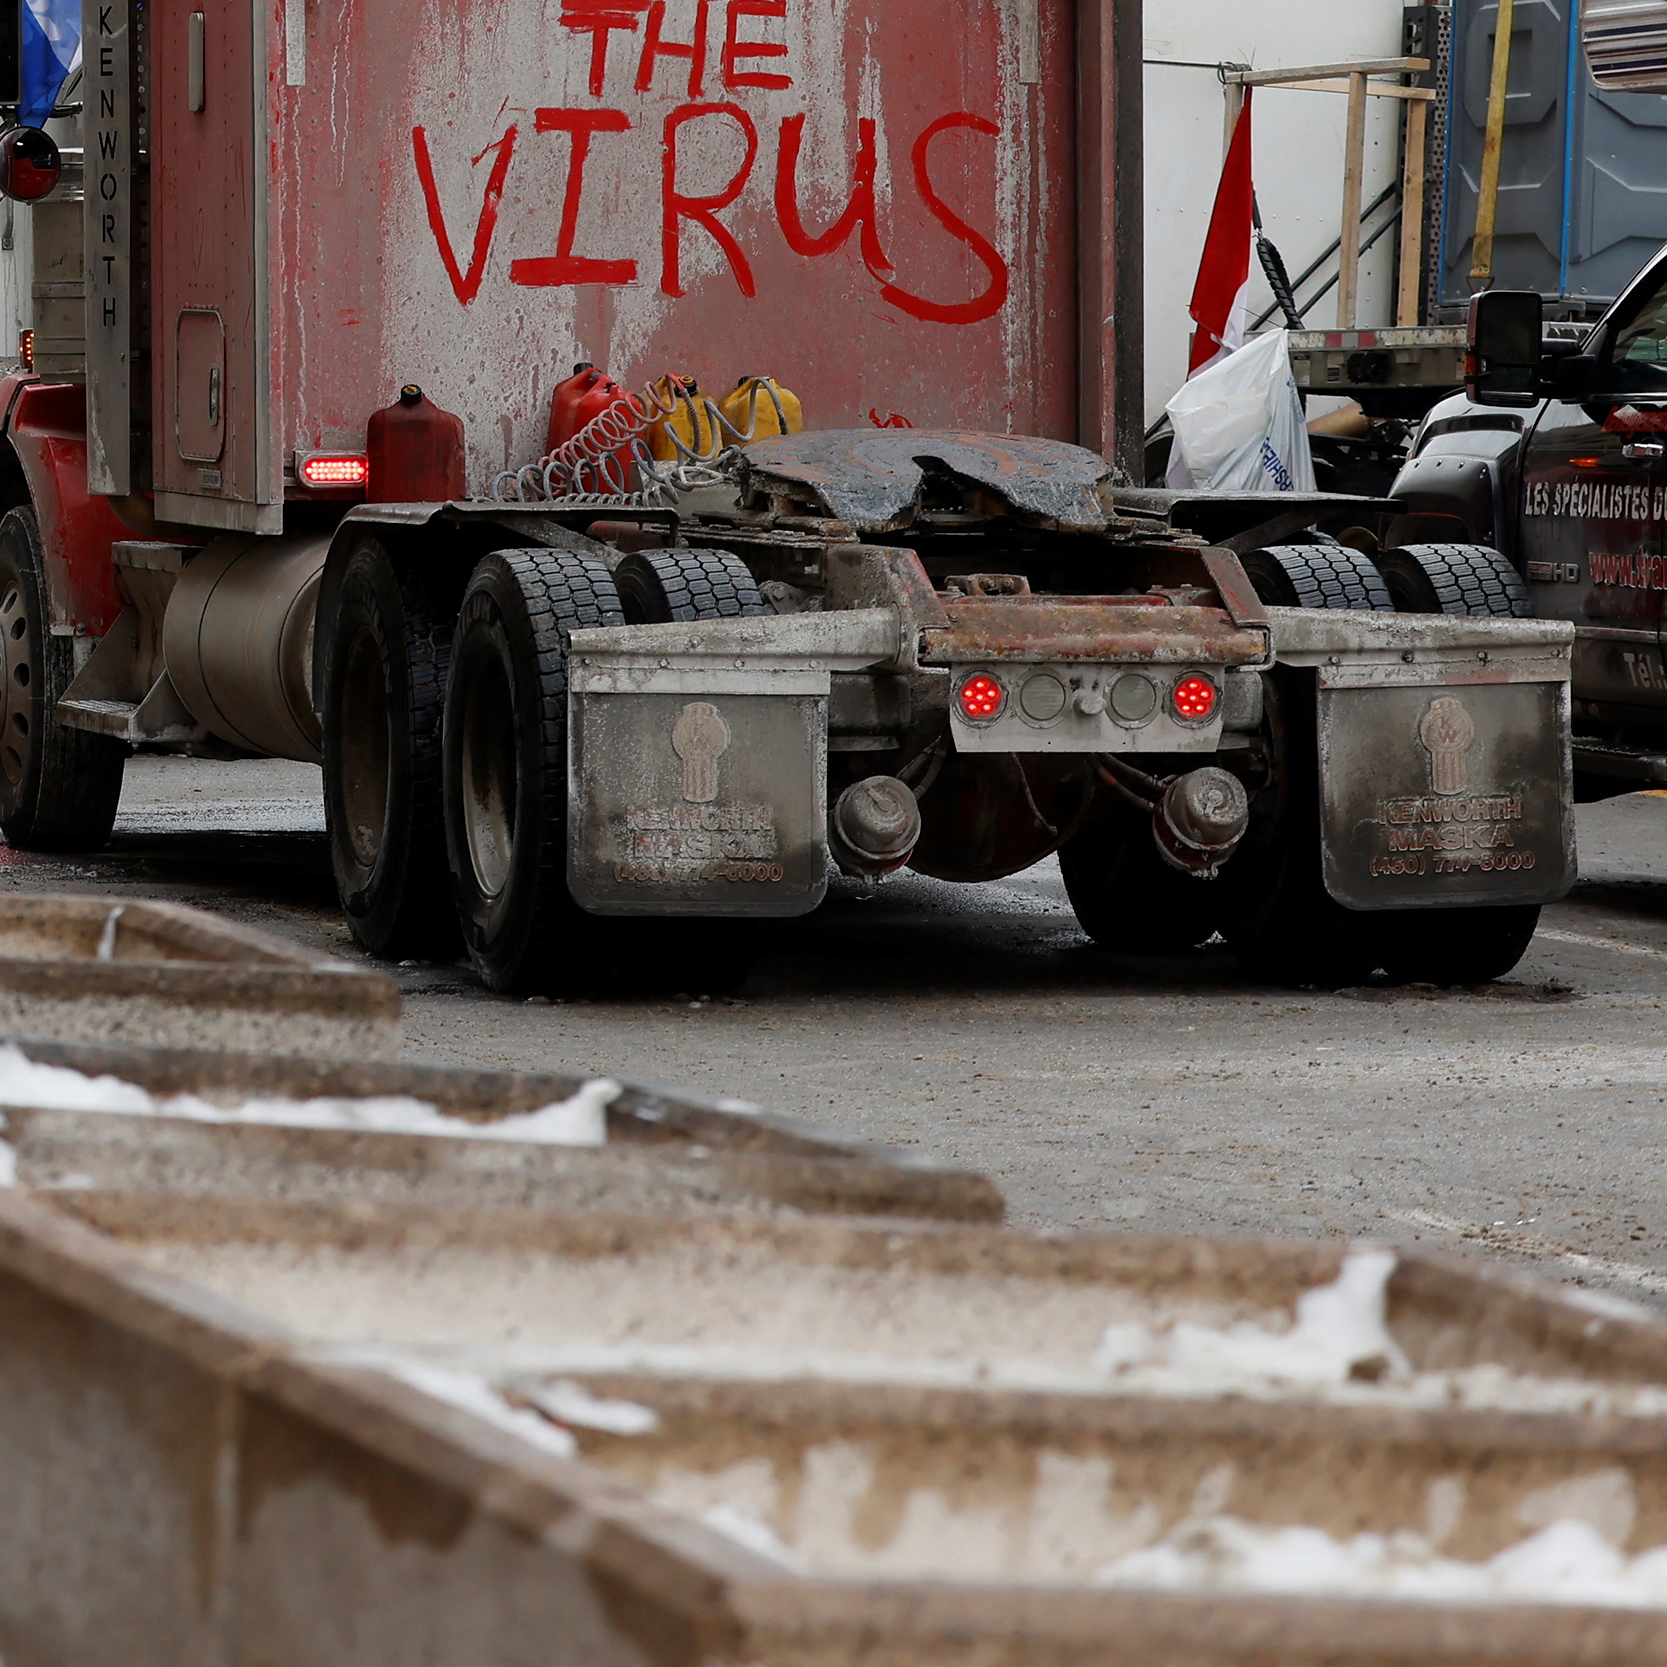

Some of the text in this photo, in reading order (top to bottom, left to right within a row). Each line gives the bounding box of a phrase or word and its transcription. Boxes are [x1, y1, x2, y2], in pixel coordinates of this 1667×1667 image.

[559, 0, 793, 97] THE
[98, 6, 118, 327] KENWORTH
[411, 101, 1008, 325] VIRUS
[1525, 481, 1549, 516] LES
[1552, 475, 1649, 520] SPÉCIALISTES
[1377, 796, 1522, 825] KENWORTH
[1388, 824, 1515, 852] MASKA
